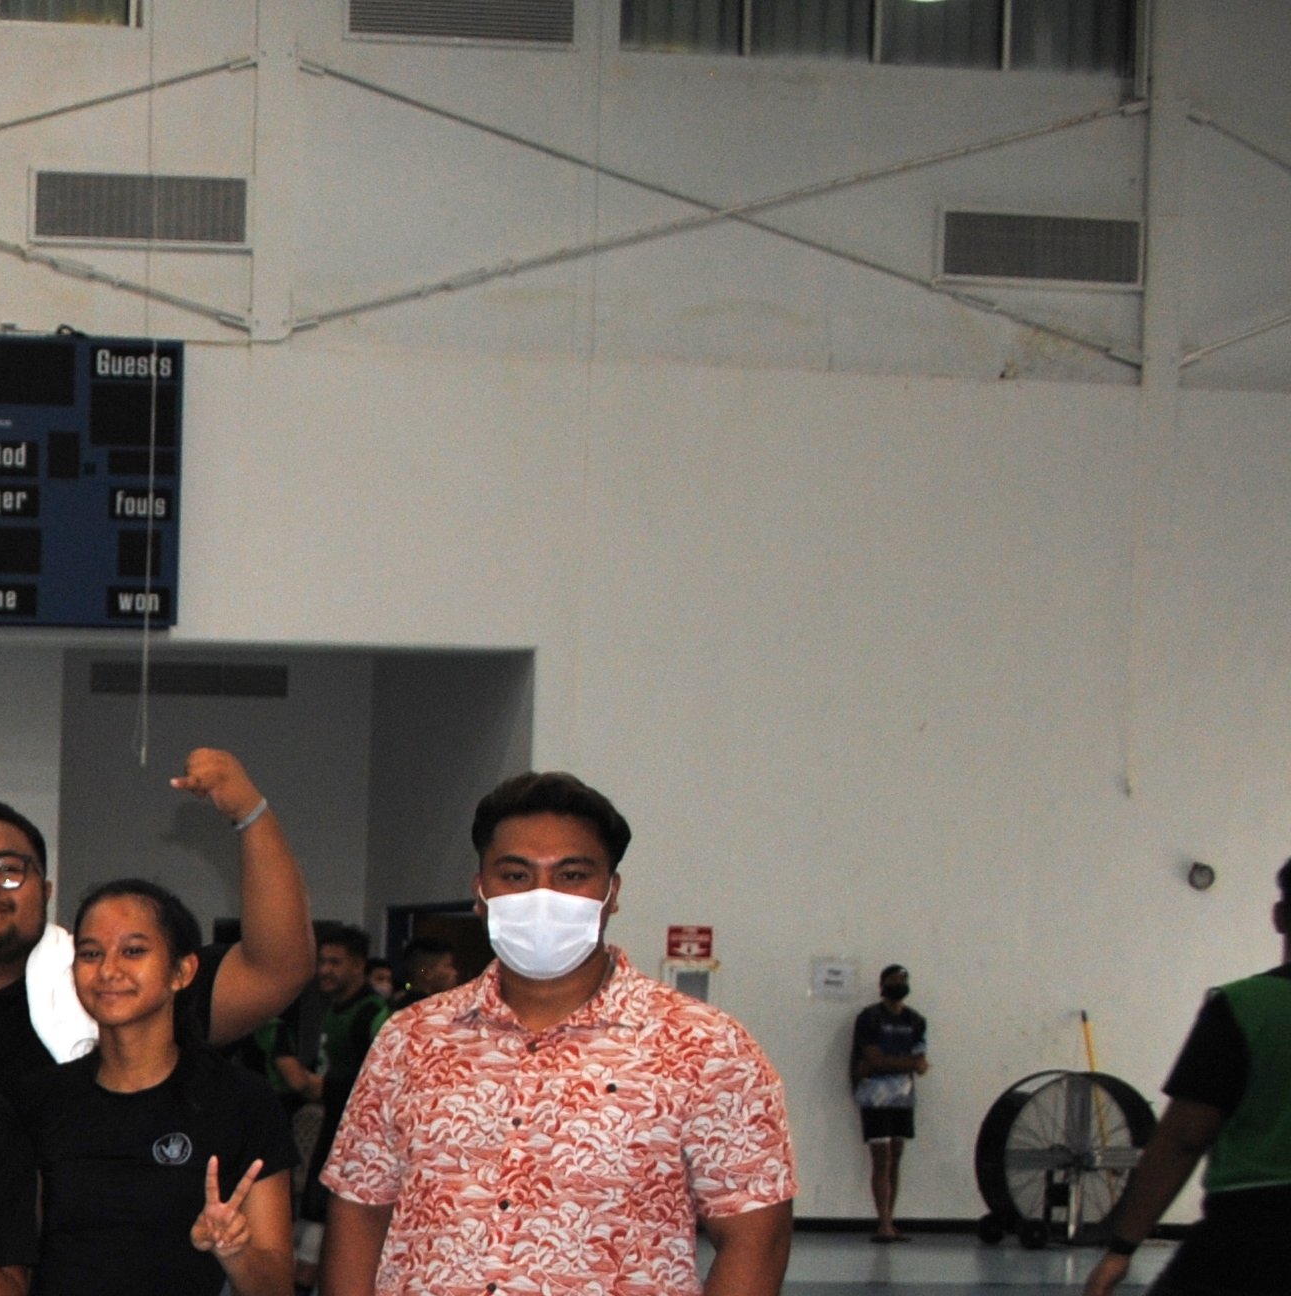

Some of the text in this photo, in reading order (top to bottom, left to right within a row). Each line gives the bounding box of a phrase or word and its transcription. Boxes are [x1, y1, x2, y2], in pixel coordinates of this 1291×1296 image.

[96, 350, 172, 377] Guests
[114, 491, 166, 517] fouls
[119, 592, 159, 612] won
